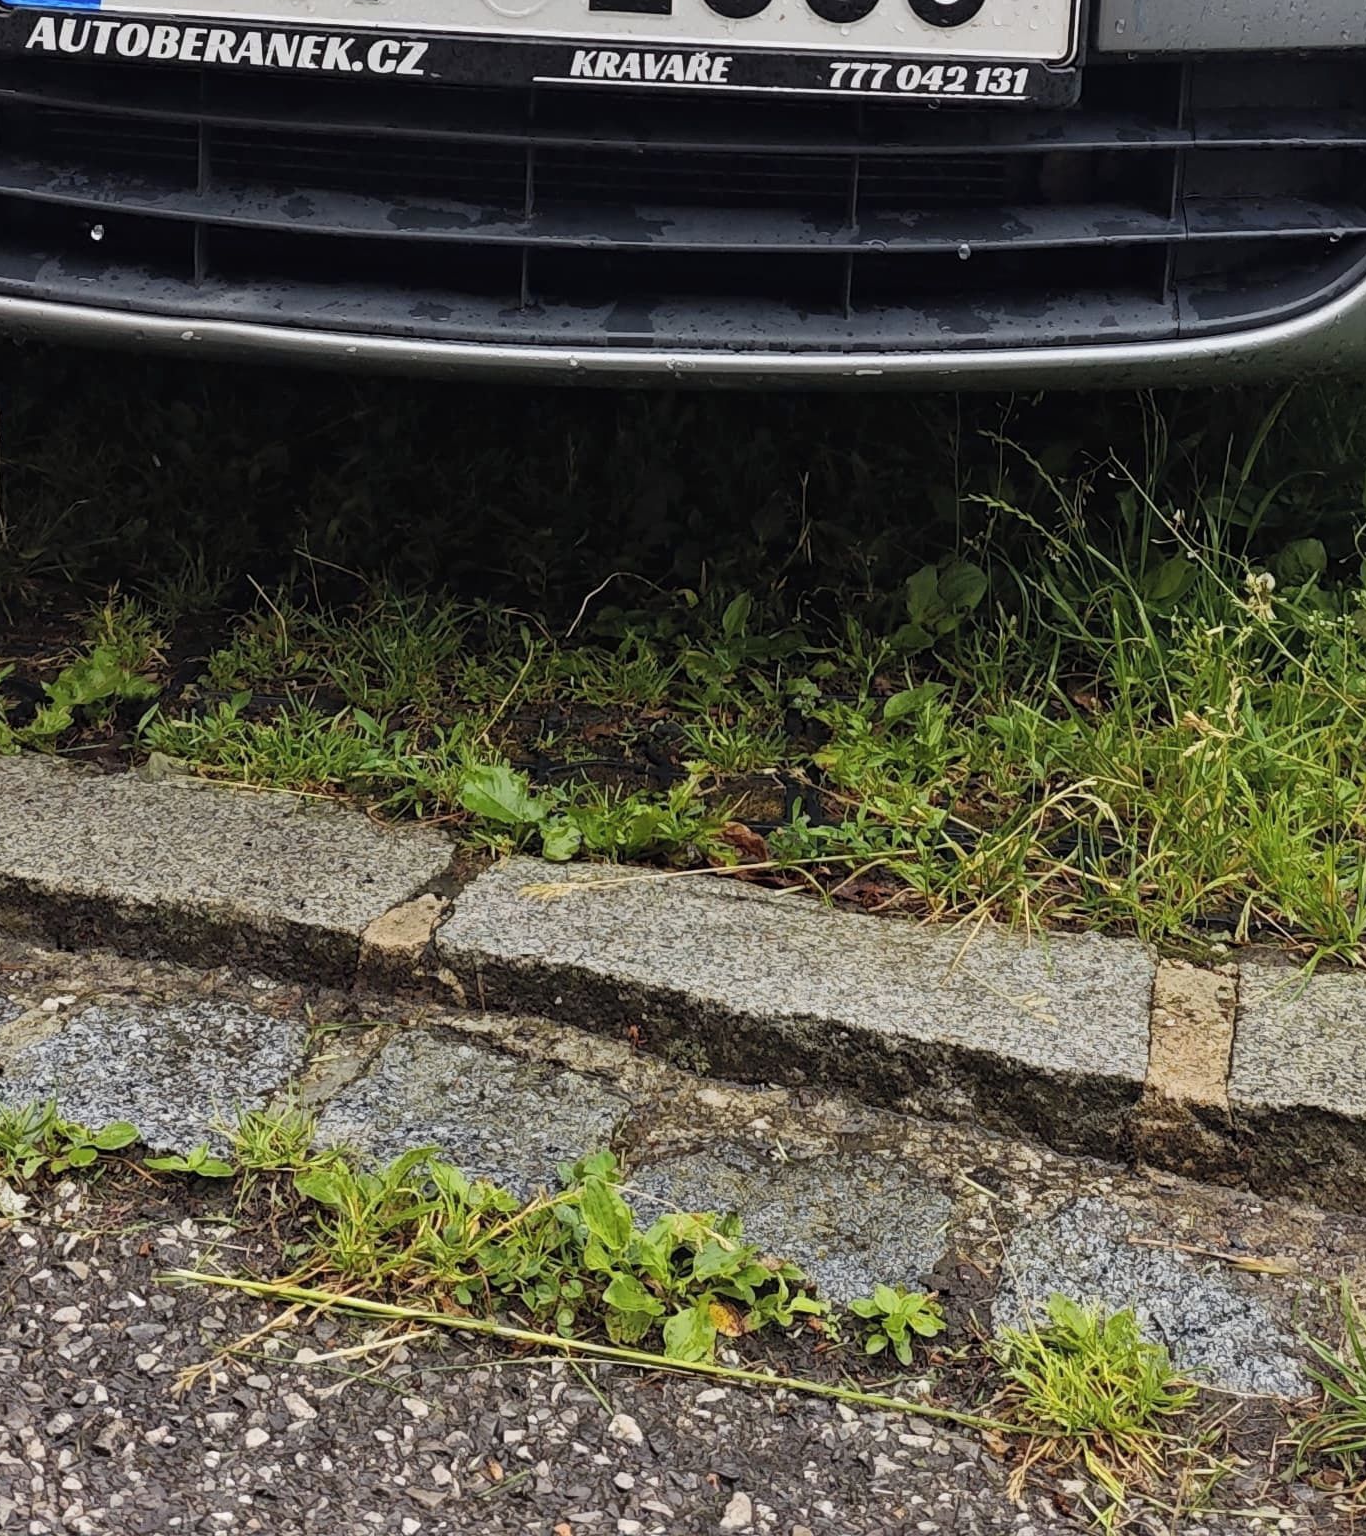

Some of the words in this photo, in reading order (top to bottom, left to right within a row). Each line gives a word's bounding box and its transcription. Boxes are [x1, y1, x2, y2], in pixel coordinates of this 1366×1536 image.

[25, 16, 430, 76] AUTOBERANEK.CZ
[569, 50, 733, 83] KRAVAŘE
[830, 62, 892, 89] 777
[896, 64, 968, 91] 042
[975, 67, 1029, 94] 131
